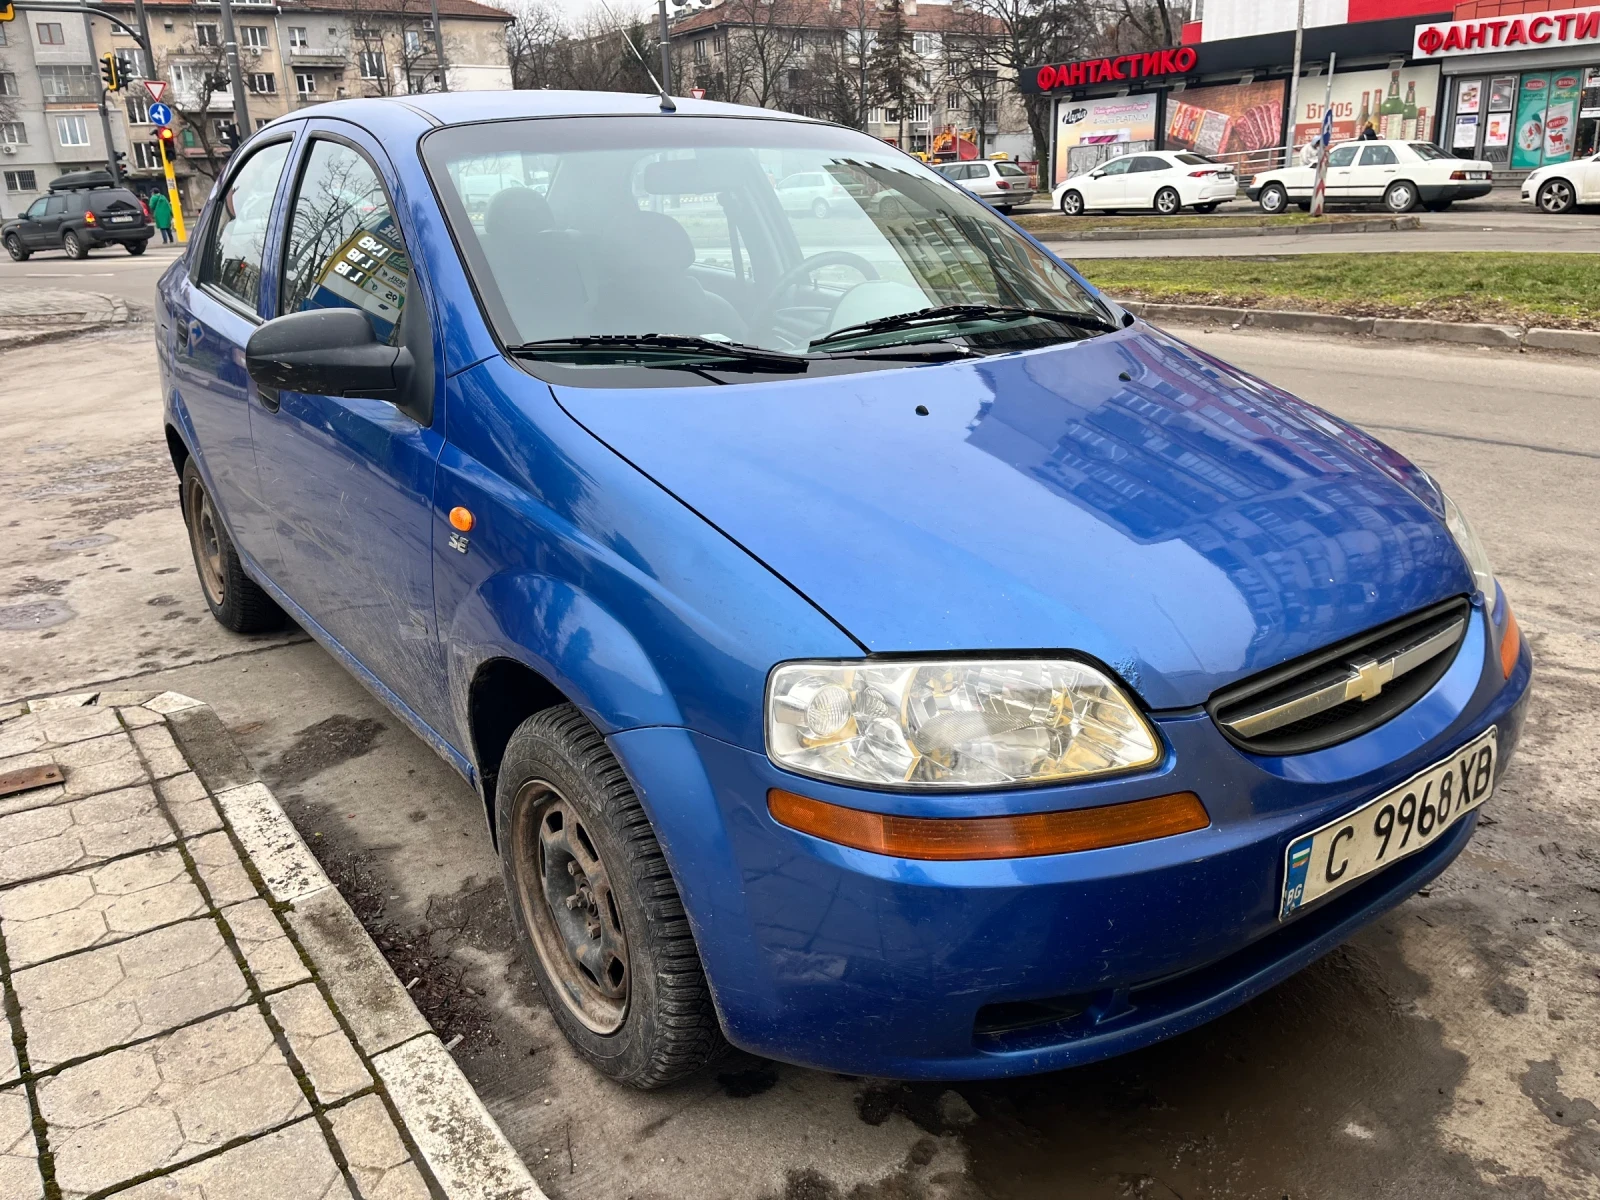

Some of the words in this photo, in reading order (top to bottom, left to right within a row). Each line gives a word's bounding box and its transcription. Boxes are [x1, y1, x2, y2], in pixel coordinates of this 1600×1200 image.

[1037, 47, 1197, 91] ФАНТАСТИКО
[1306, 101, 1353, 119] Brtos
[449, 532, 469, 554] SE
[1325, 825, 1354, 883] C
[1287, 883, 1303, 906] BG
